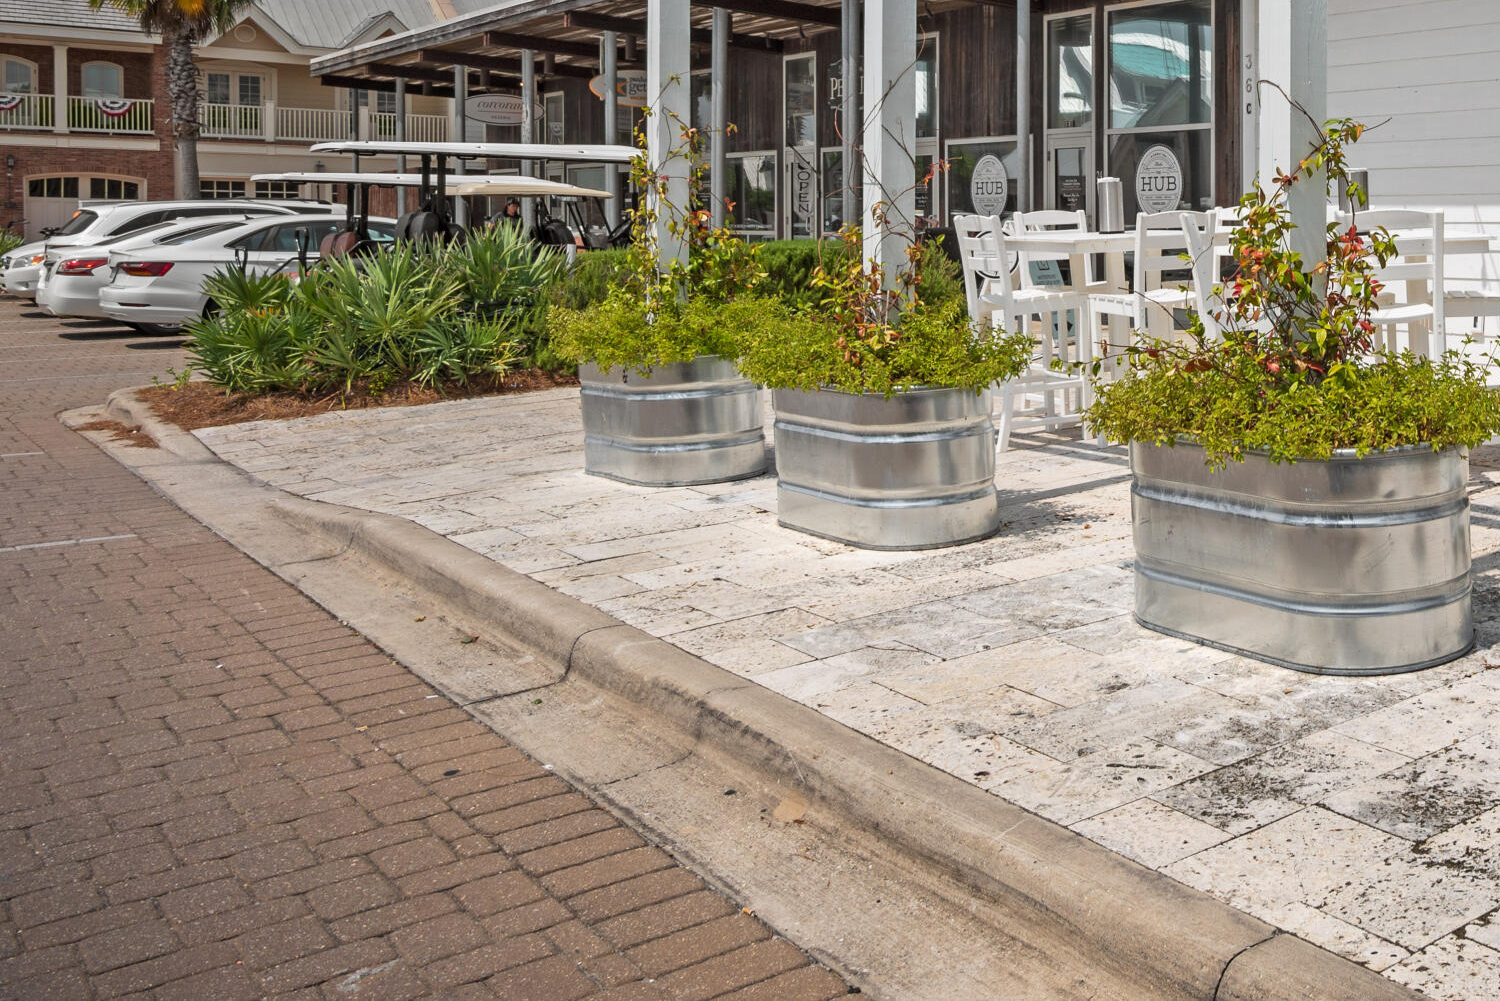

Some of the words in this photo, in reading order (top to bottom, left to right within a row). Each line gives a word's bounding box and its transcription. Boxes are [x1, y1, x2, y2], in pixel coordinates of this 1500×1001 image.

[797, 169, 811, 214] OPEN
[975, 181, 1004, 196] HUB
[1140, 175, 1177, 192] HUB
